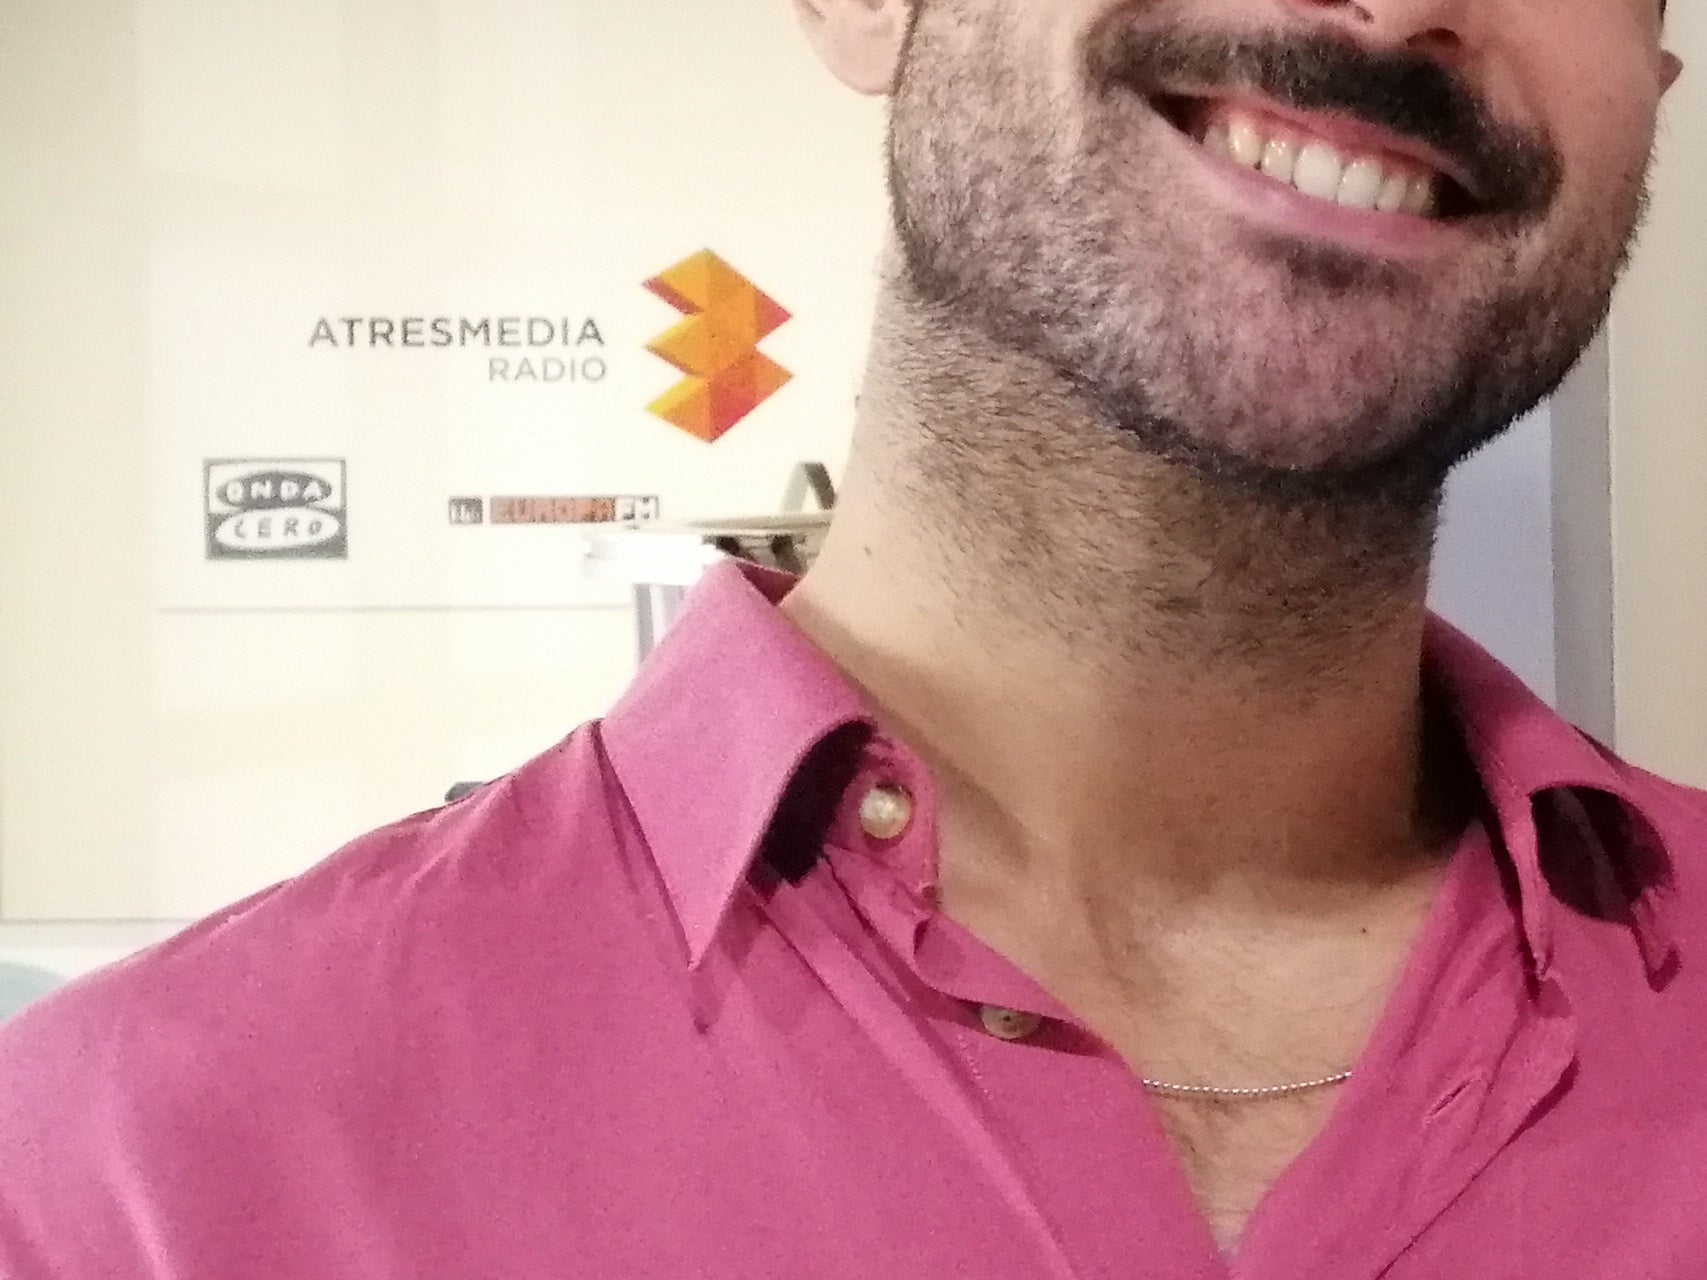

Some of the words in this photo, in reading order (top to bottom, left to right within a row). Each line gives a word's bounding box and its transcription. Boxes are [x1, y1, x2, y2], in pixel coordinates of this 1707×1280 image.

[308, 316, 606, 347] ATRESMEDIA
[488, 356, 607, 383] RADIO
[225, 479, 325, 503] ONDA
[233, 517, 323, 539] CERO
